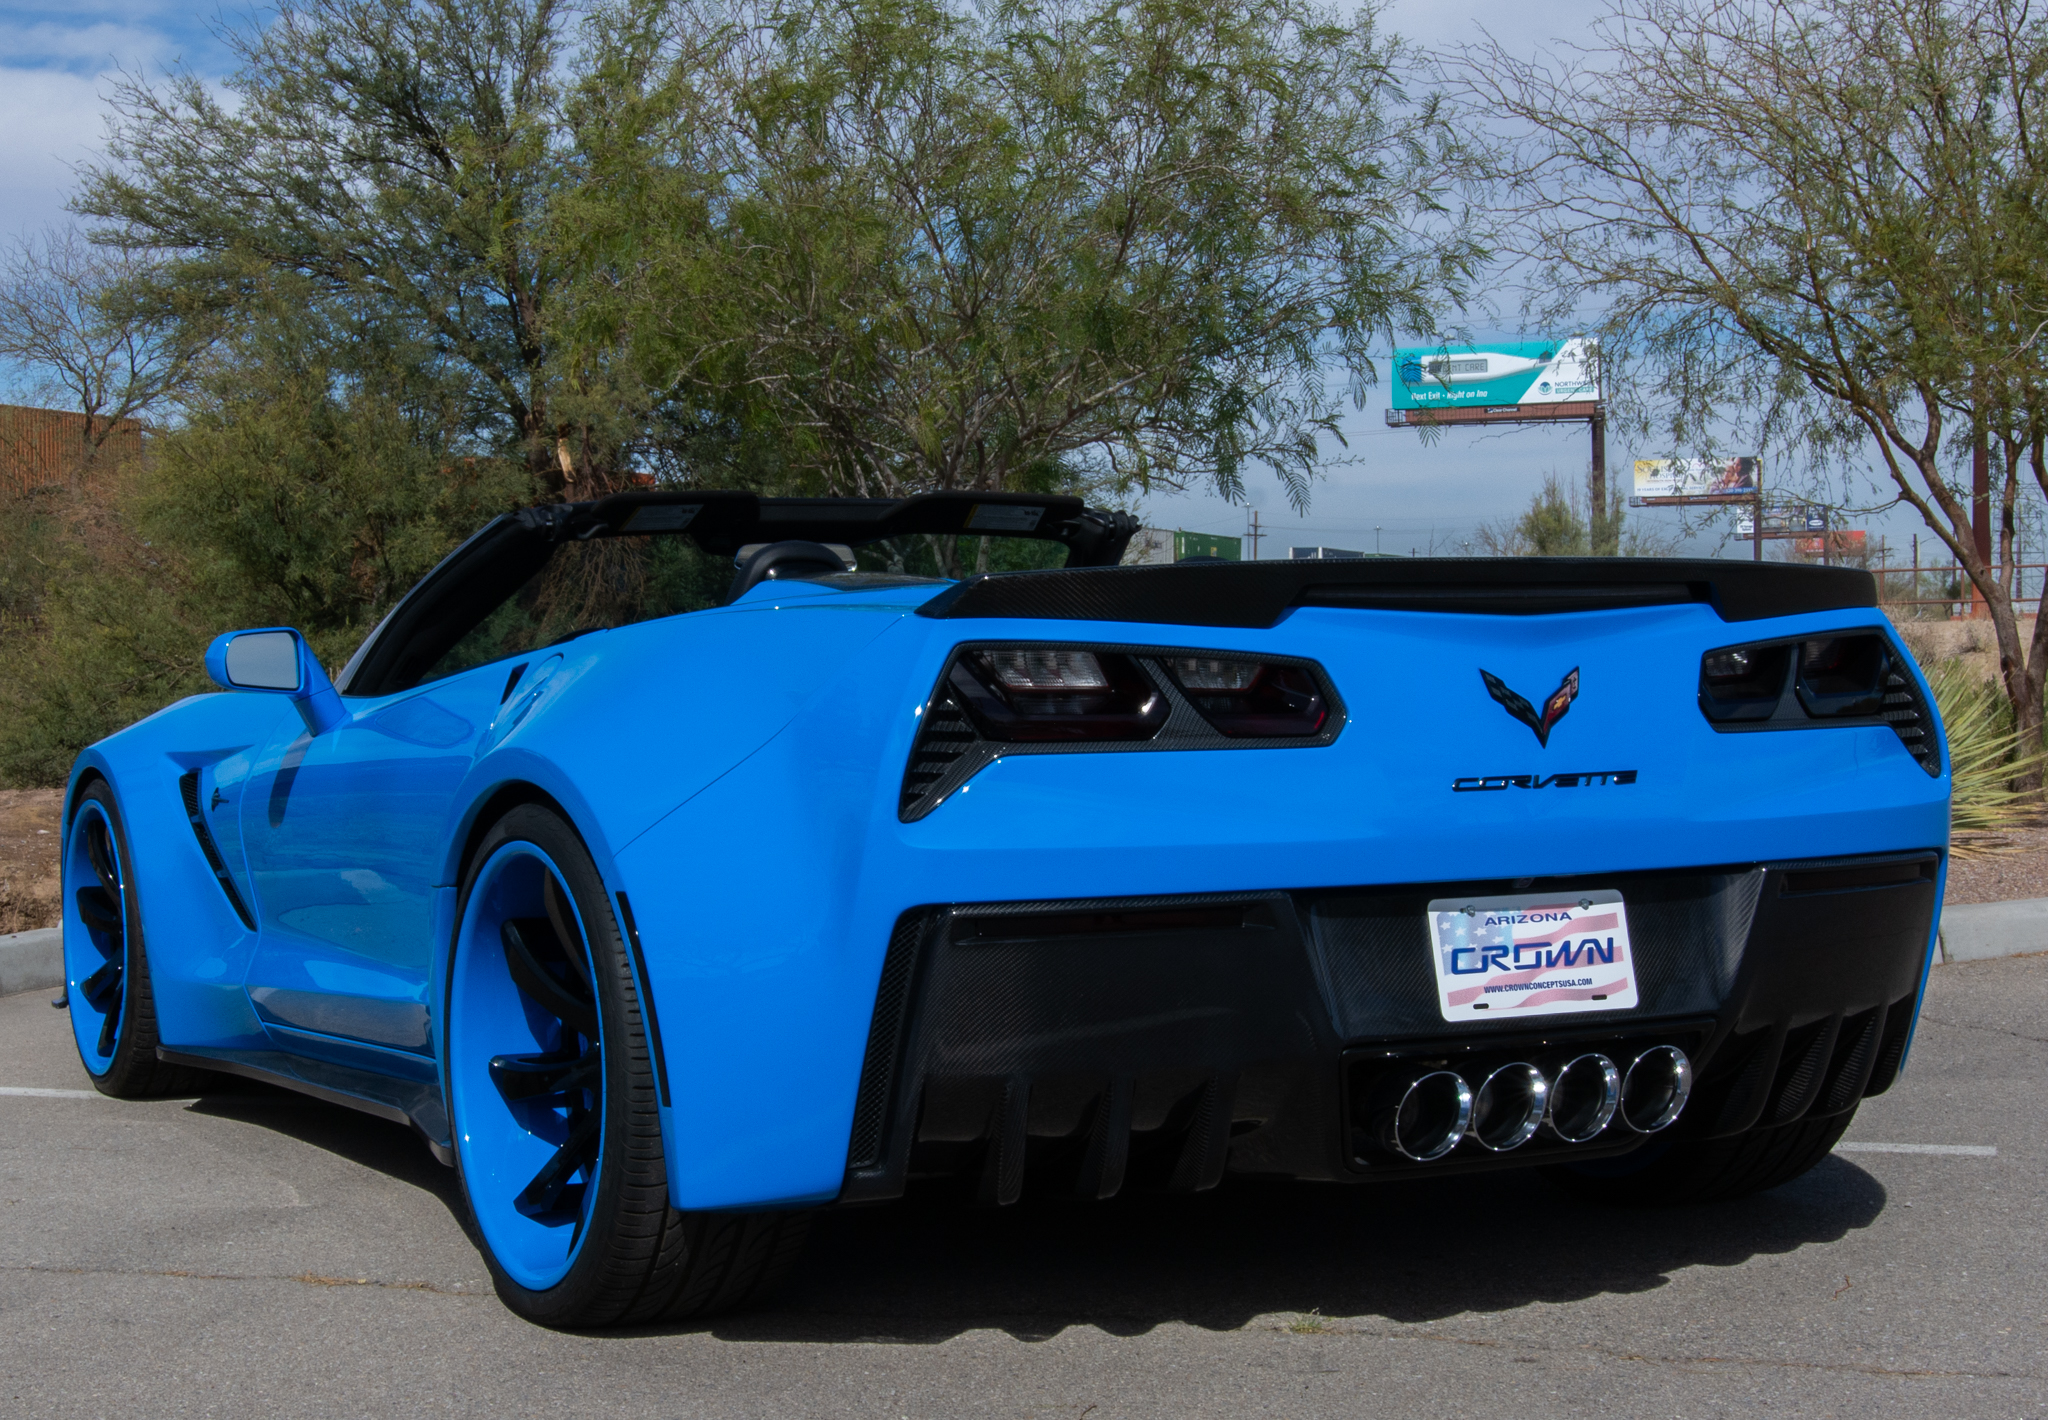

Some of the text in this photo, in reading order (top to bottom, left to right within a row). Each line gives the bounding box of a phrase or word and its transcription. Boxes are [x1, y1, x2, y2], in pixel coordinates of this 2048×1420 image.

[1464, 363, 1484, 372] CARE
[1411, 392, 1427, 401] Next
[1428, 391, 1441, 400] Exit
[1446, 390, 1465, 401] Right
[1452, 769, 1638, 792] CORVETTE
[1484, 912, 1572, 927] ARIZONA
[1451, 937, 1614, 975] CROWN
[1483, 978, 1593, 994] WWW.CROWNCONCEPTSUSA.COM
